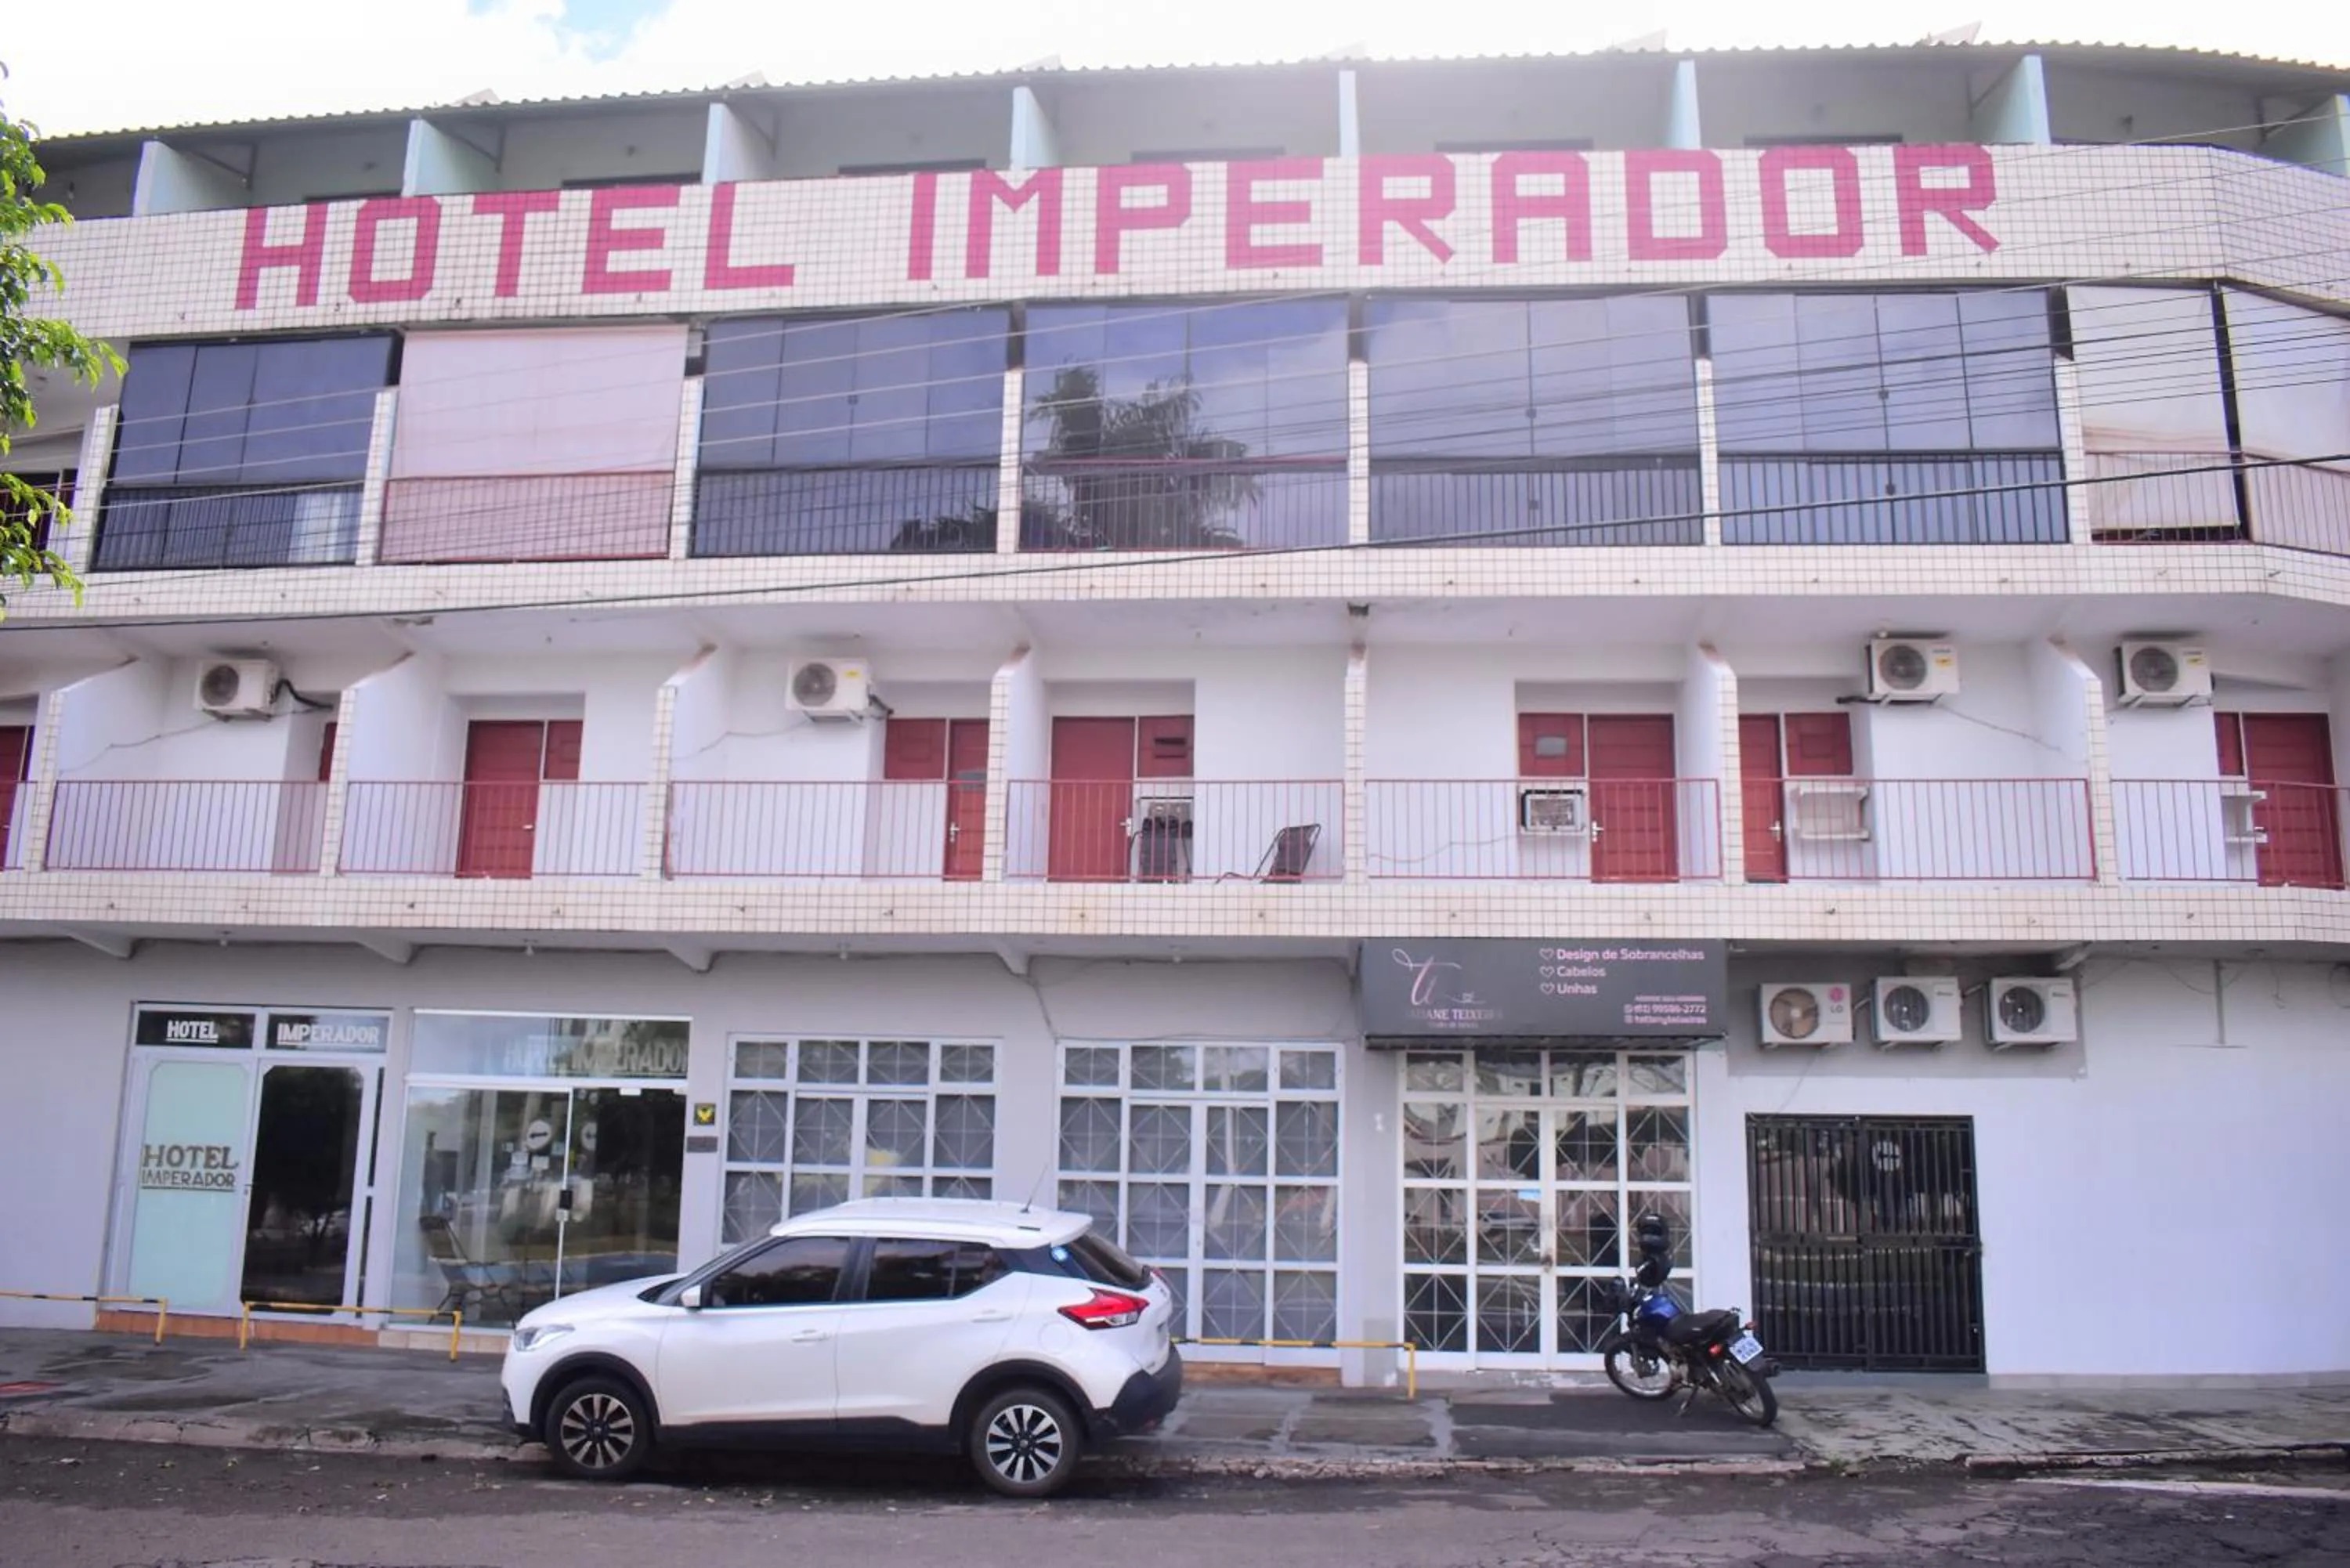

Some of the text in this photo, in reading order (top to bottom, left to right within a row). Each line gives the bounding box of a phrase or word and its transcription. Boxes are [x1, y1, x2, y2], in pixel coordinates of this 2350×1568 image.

[234, 145, 1999, 311] HOTEL IMPERADOR
[1556, 948, 1705, 962] Design de Sobrancelhas
[1556, 966, 1606, 977] Cabelos
[1556, 983, 1597, 994] Unhas
[167, 1021, 379, 1043] HOTEL IMPERADOR
[142, 1145, 239, 1169] HOTEL
[142, 1169, 235, 1187] IMPERADOR
